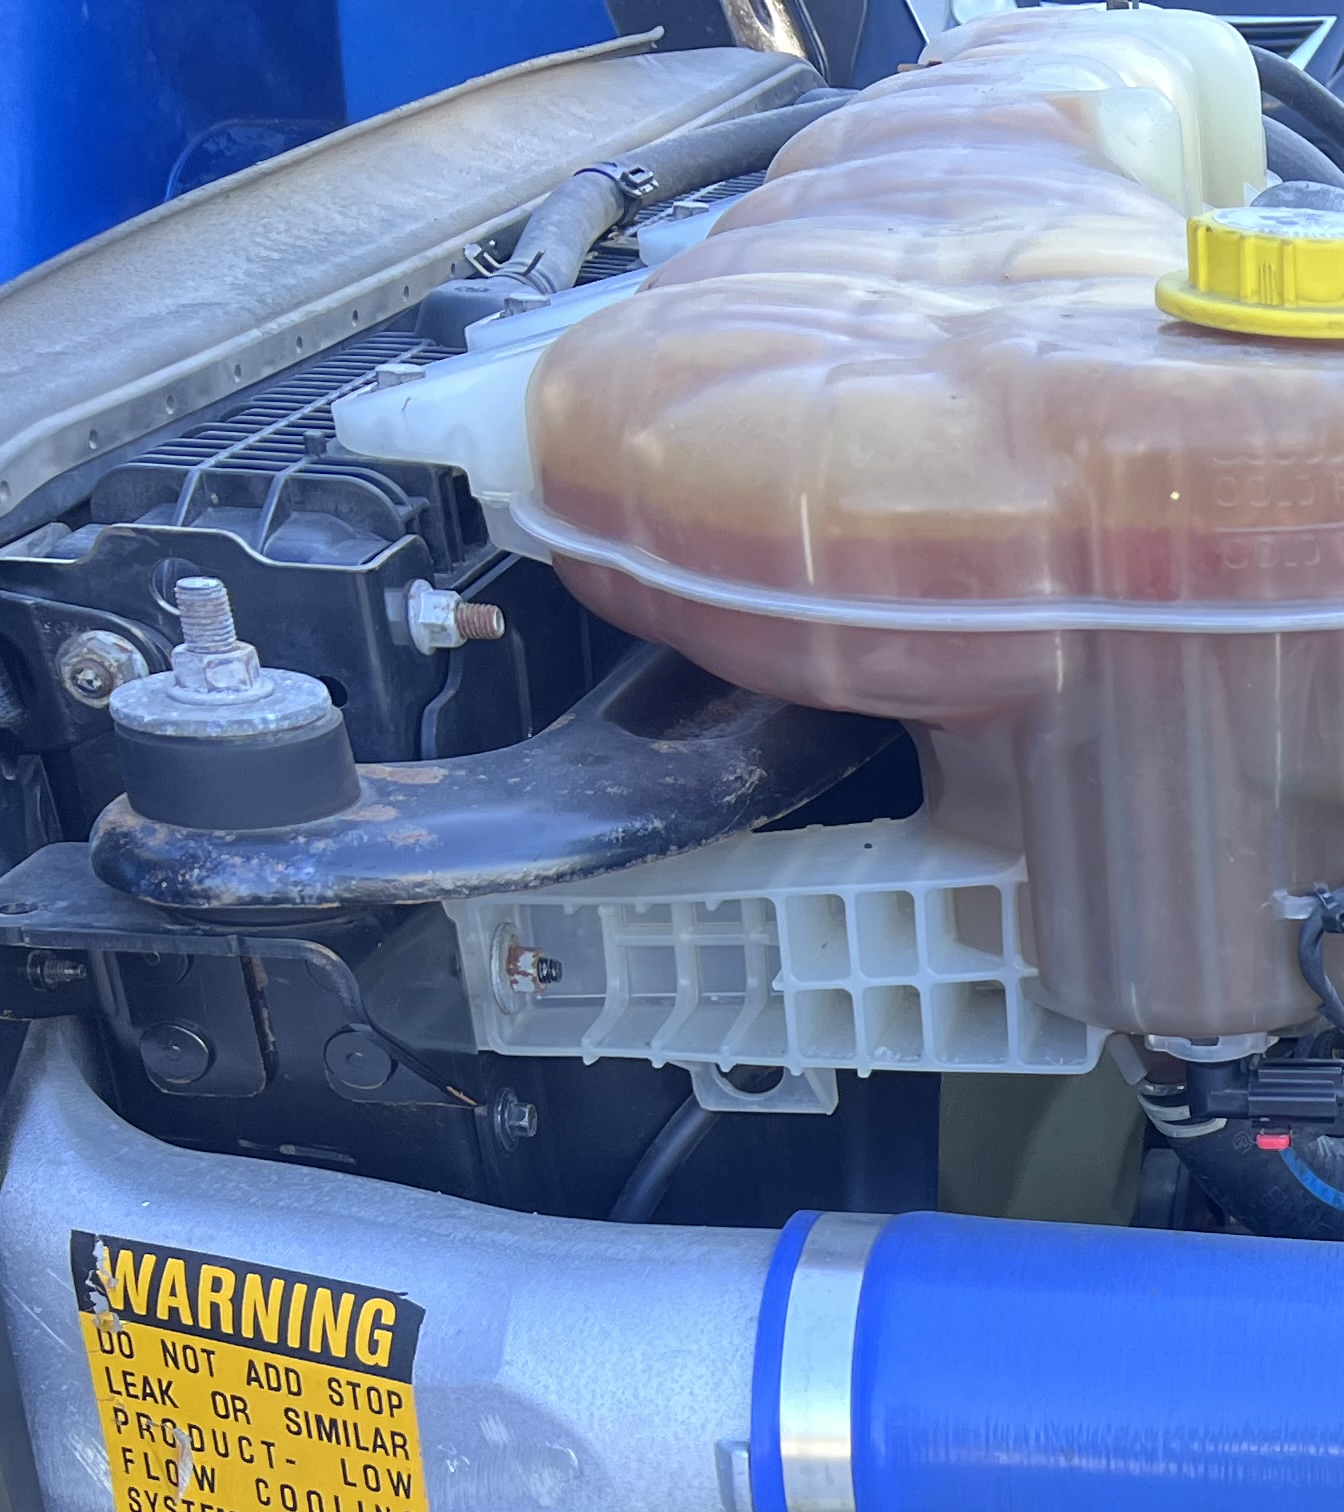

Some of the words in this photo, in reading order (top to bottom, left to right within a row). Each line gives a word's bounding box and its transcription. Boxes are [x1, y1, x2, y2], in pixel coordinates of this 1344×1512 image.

[97, 1246, 396, 1367] WARNING
[97, 1328, 134, 1359] DO
[160, 1339, 216, 1377] NOT
[246, 1359, 302, 1396] ADD
[328, 1377, 403, 1418] STOP
[105, 1366, 179, 1408] LEAK
[211, 1391, 251, 1425] OR
[284, 1407, 410, 1461] SIMILAR
[121, 1447, 216, 1494] FLOW
[341, 1458, 412, 1499] LOW
